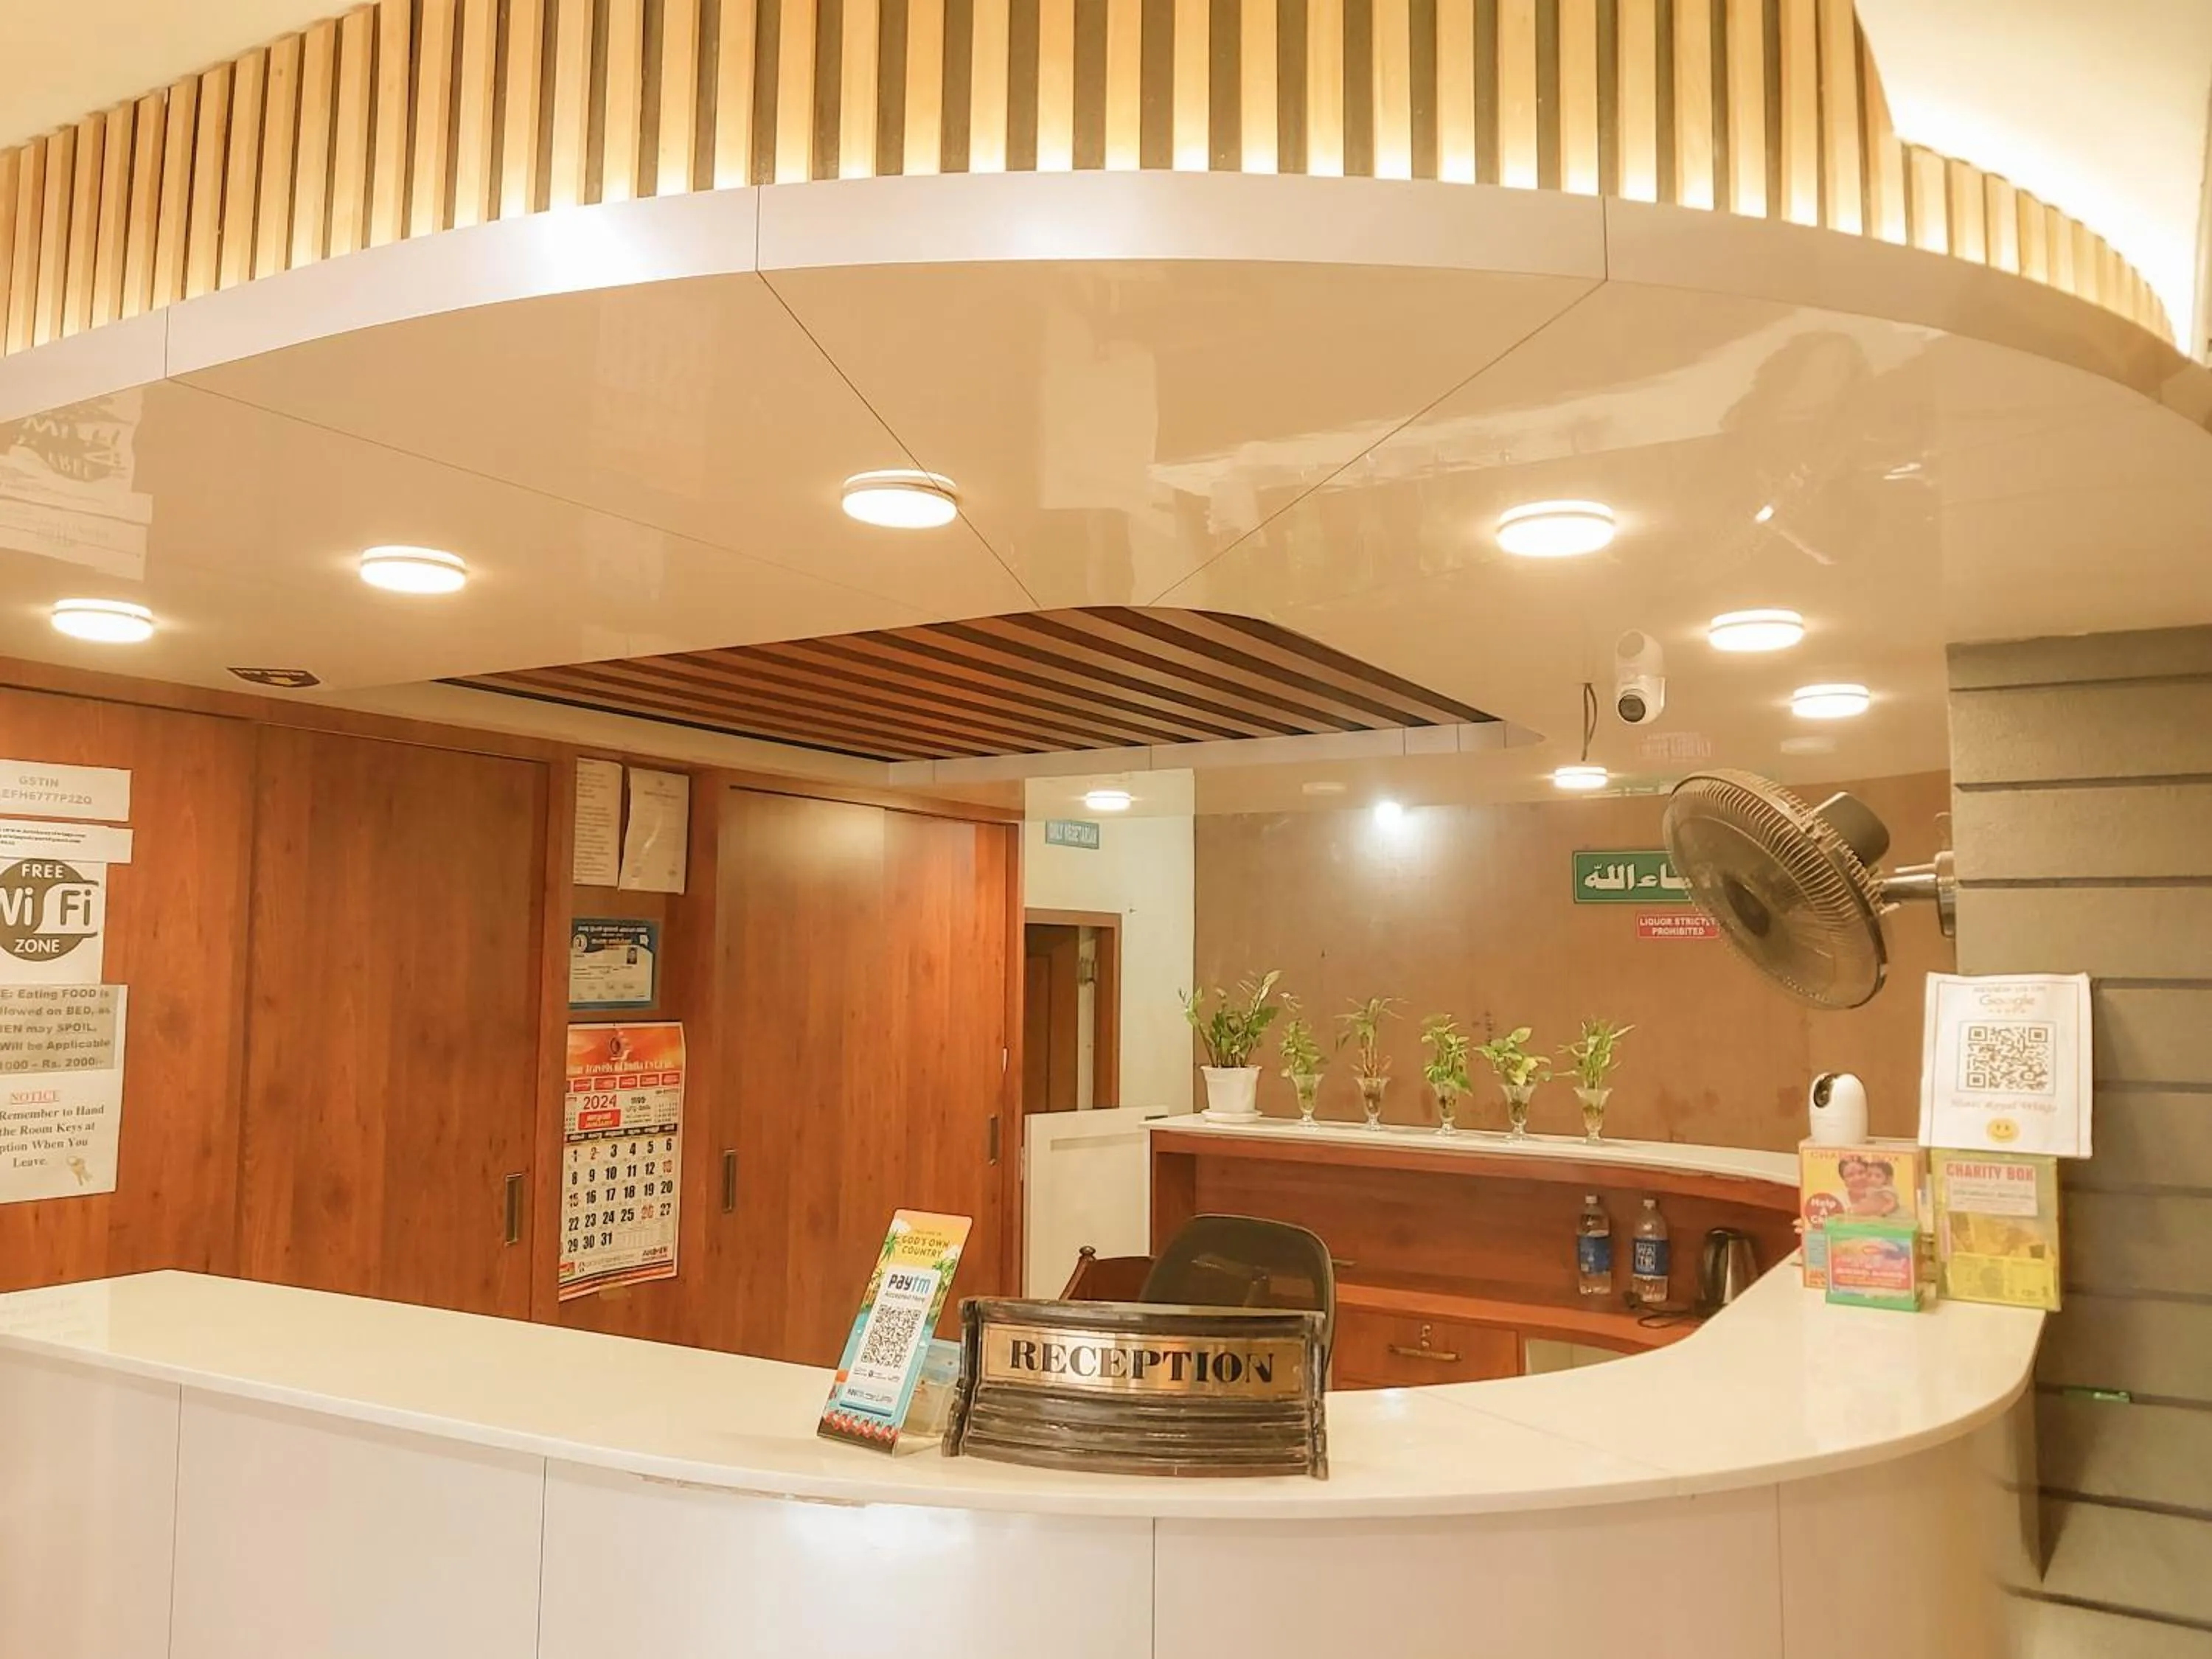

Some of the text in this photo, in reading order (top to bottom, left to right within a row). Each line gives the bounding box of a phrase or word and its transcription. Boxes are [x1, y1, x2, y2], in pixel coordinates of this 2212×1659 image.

[19, 776, 58, 787] GSTIN
[21, 863, 64, 879] FREE
[1639, 918, 1672, 926] LIQUOR
[1652, 927, 1705, 936] PROHIBITED
[14, 939, 60, 953] ZONE
[18, 989, 58, 1000] Eating
[62, 989, 97, 998] FOOD
[100, 989, 110, 998] is
[66, 1006, 94, 1017] BED,
[26, 1026, 53, 1034] may
[0, 1039, 111, 1051] Will be Applicable
[11, 1090, 59, 1103] NOTICE
[583, 1094, 617, 1110] 2024
[0, 1104, 105, 1120] Remember to Hand
[20, 1124, 52, 1135] Room
[56, 1123, 82, 1134] Keys
[85, 1122, 95, 1130] at
[32, 1139, 64, 1149] When
[68, 1138, 88, 1147] You
[591, 1147, 597, 1160] 2
[611, 1144, 617, 1158] 3
[630, 1143, 636, 1155] 4
[647, 1141, 654, 1153] 5
[666, 1138, 672, 1151] 6
[571, 1171, 577, 1185] 8
[589, 1169, 595, 1182] 9
[605, 1166, 617, 1180] 10
[627, 1164, 637, 1178] 11
[645, 1161, 655, 1175] 12
[1947, 1164, 2034, 1181] CHARITY BOX
[568, 1180, 672, 1208] 15 16 17 18 19 20
[1811, 1198, 1836, 1209] Help
[568, 1217, 579, 1232] 22
[585, 1213, 597, 1228] 23
[602, 1211, 615, 1225] 24
[620, 1208, 634, 1222] 25
[660, 1203, 671, 1217] 27
[567, 1232, 613, 1253] 29 30 31
[928, 1238, 950, 1248] OWN
[902, 1245, 943, 1258] COUNTRY
[1009, 1339, 1274, 1384] RECEPTION
